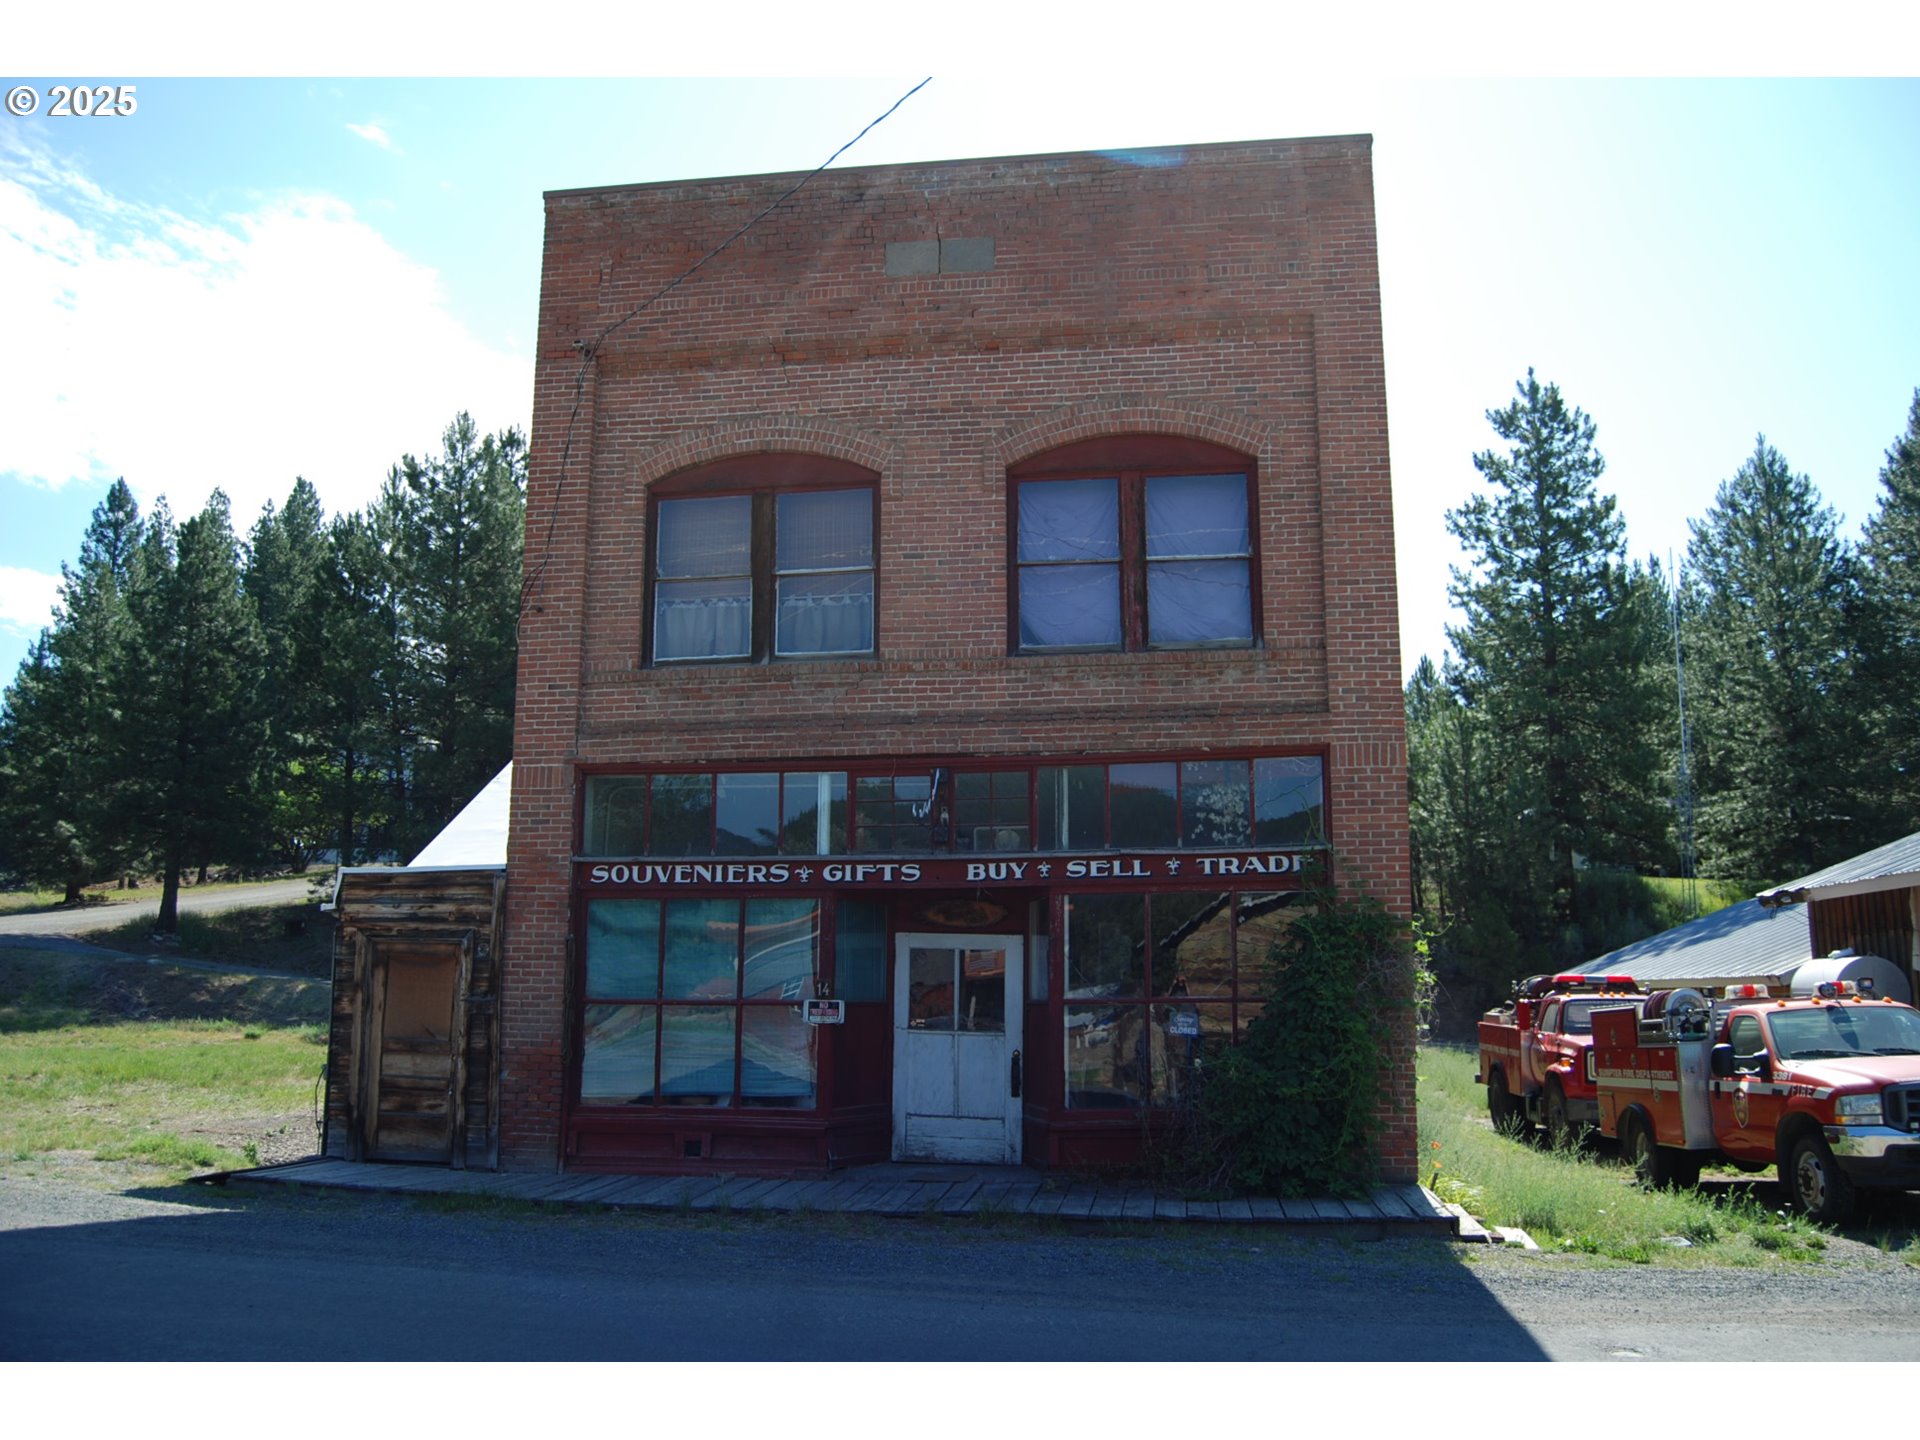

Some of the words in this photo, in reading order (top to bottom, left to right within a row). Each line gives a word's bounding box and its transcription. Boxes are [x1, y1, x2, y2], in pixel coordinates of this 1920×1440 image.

[590, 863, 790, 883] SOUVENIERS
[823, 863, 921, 882] GIFTS
[966, 862, 1029, 881] BUY
[1066, 859, 1151, 878] SELL
[817, 982, 830, 996] 14
[819, 1001, 829, 1009] NO
[1170, 1026, 1197, 1035] CLOSED
[1791, 1084, 1814, 1099] FIRE
